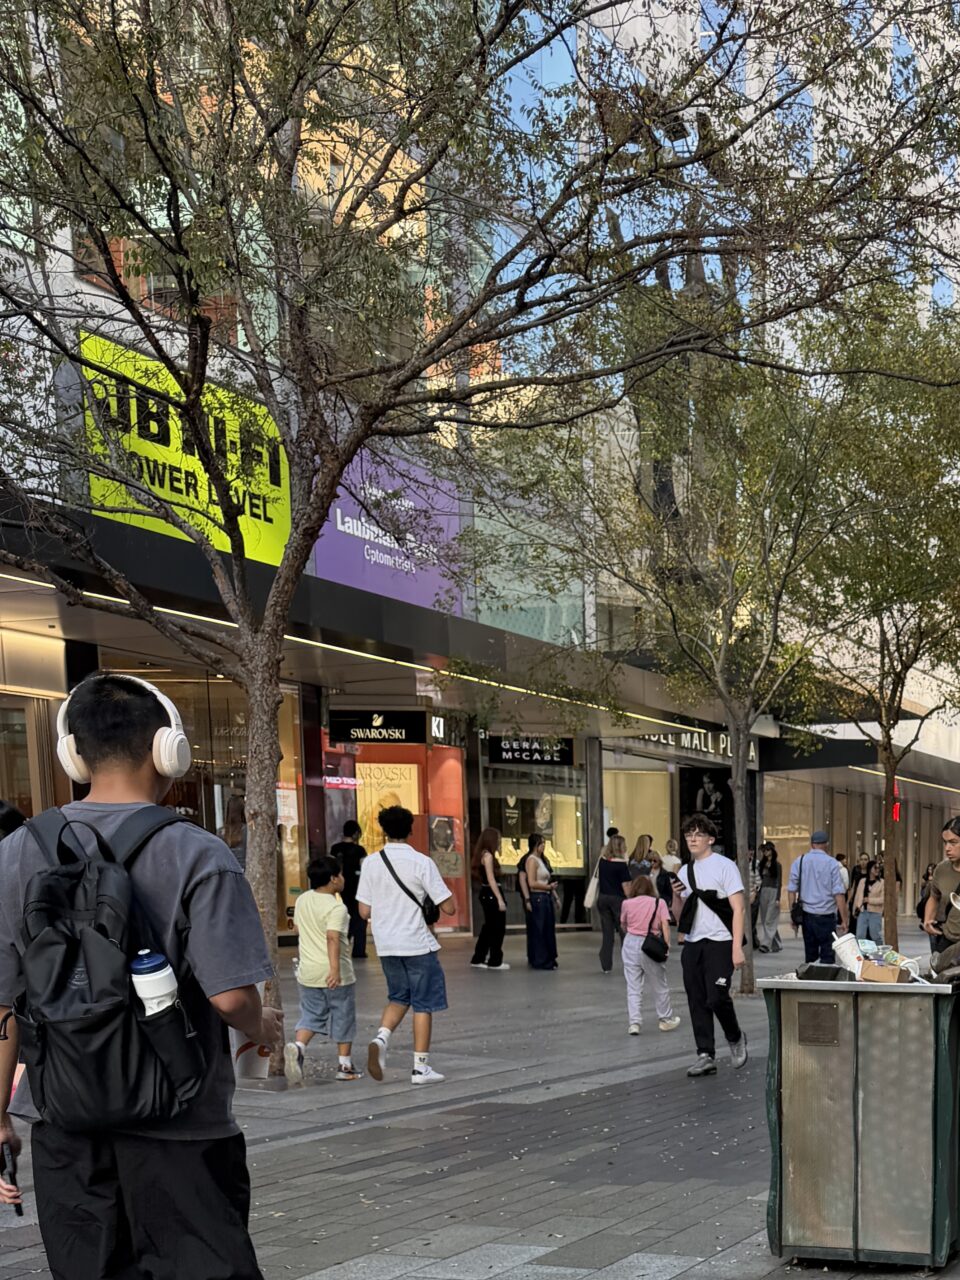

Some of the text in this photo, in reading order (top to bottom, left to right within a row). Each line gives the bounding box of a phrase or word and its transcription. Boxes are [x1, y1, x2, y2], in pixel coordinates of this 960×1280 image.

[114, 446, 274, 525] OWER LVEL
[350, 728, 405, 739] SWAROVSKI
[681, 732, 715, 753] MALL
[719, 734, 756, 761] PLA
